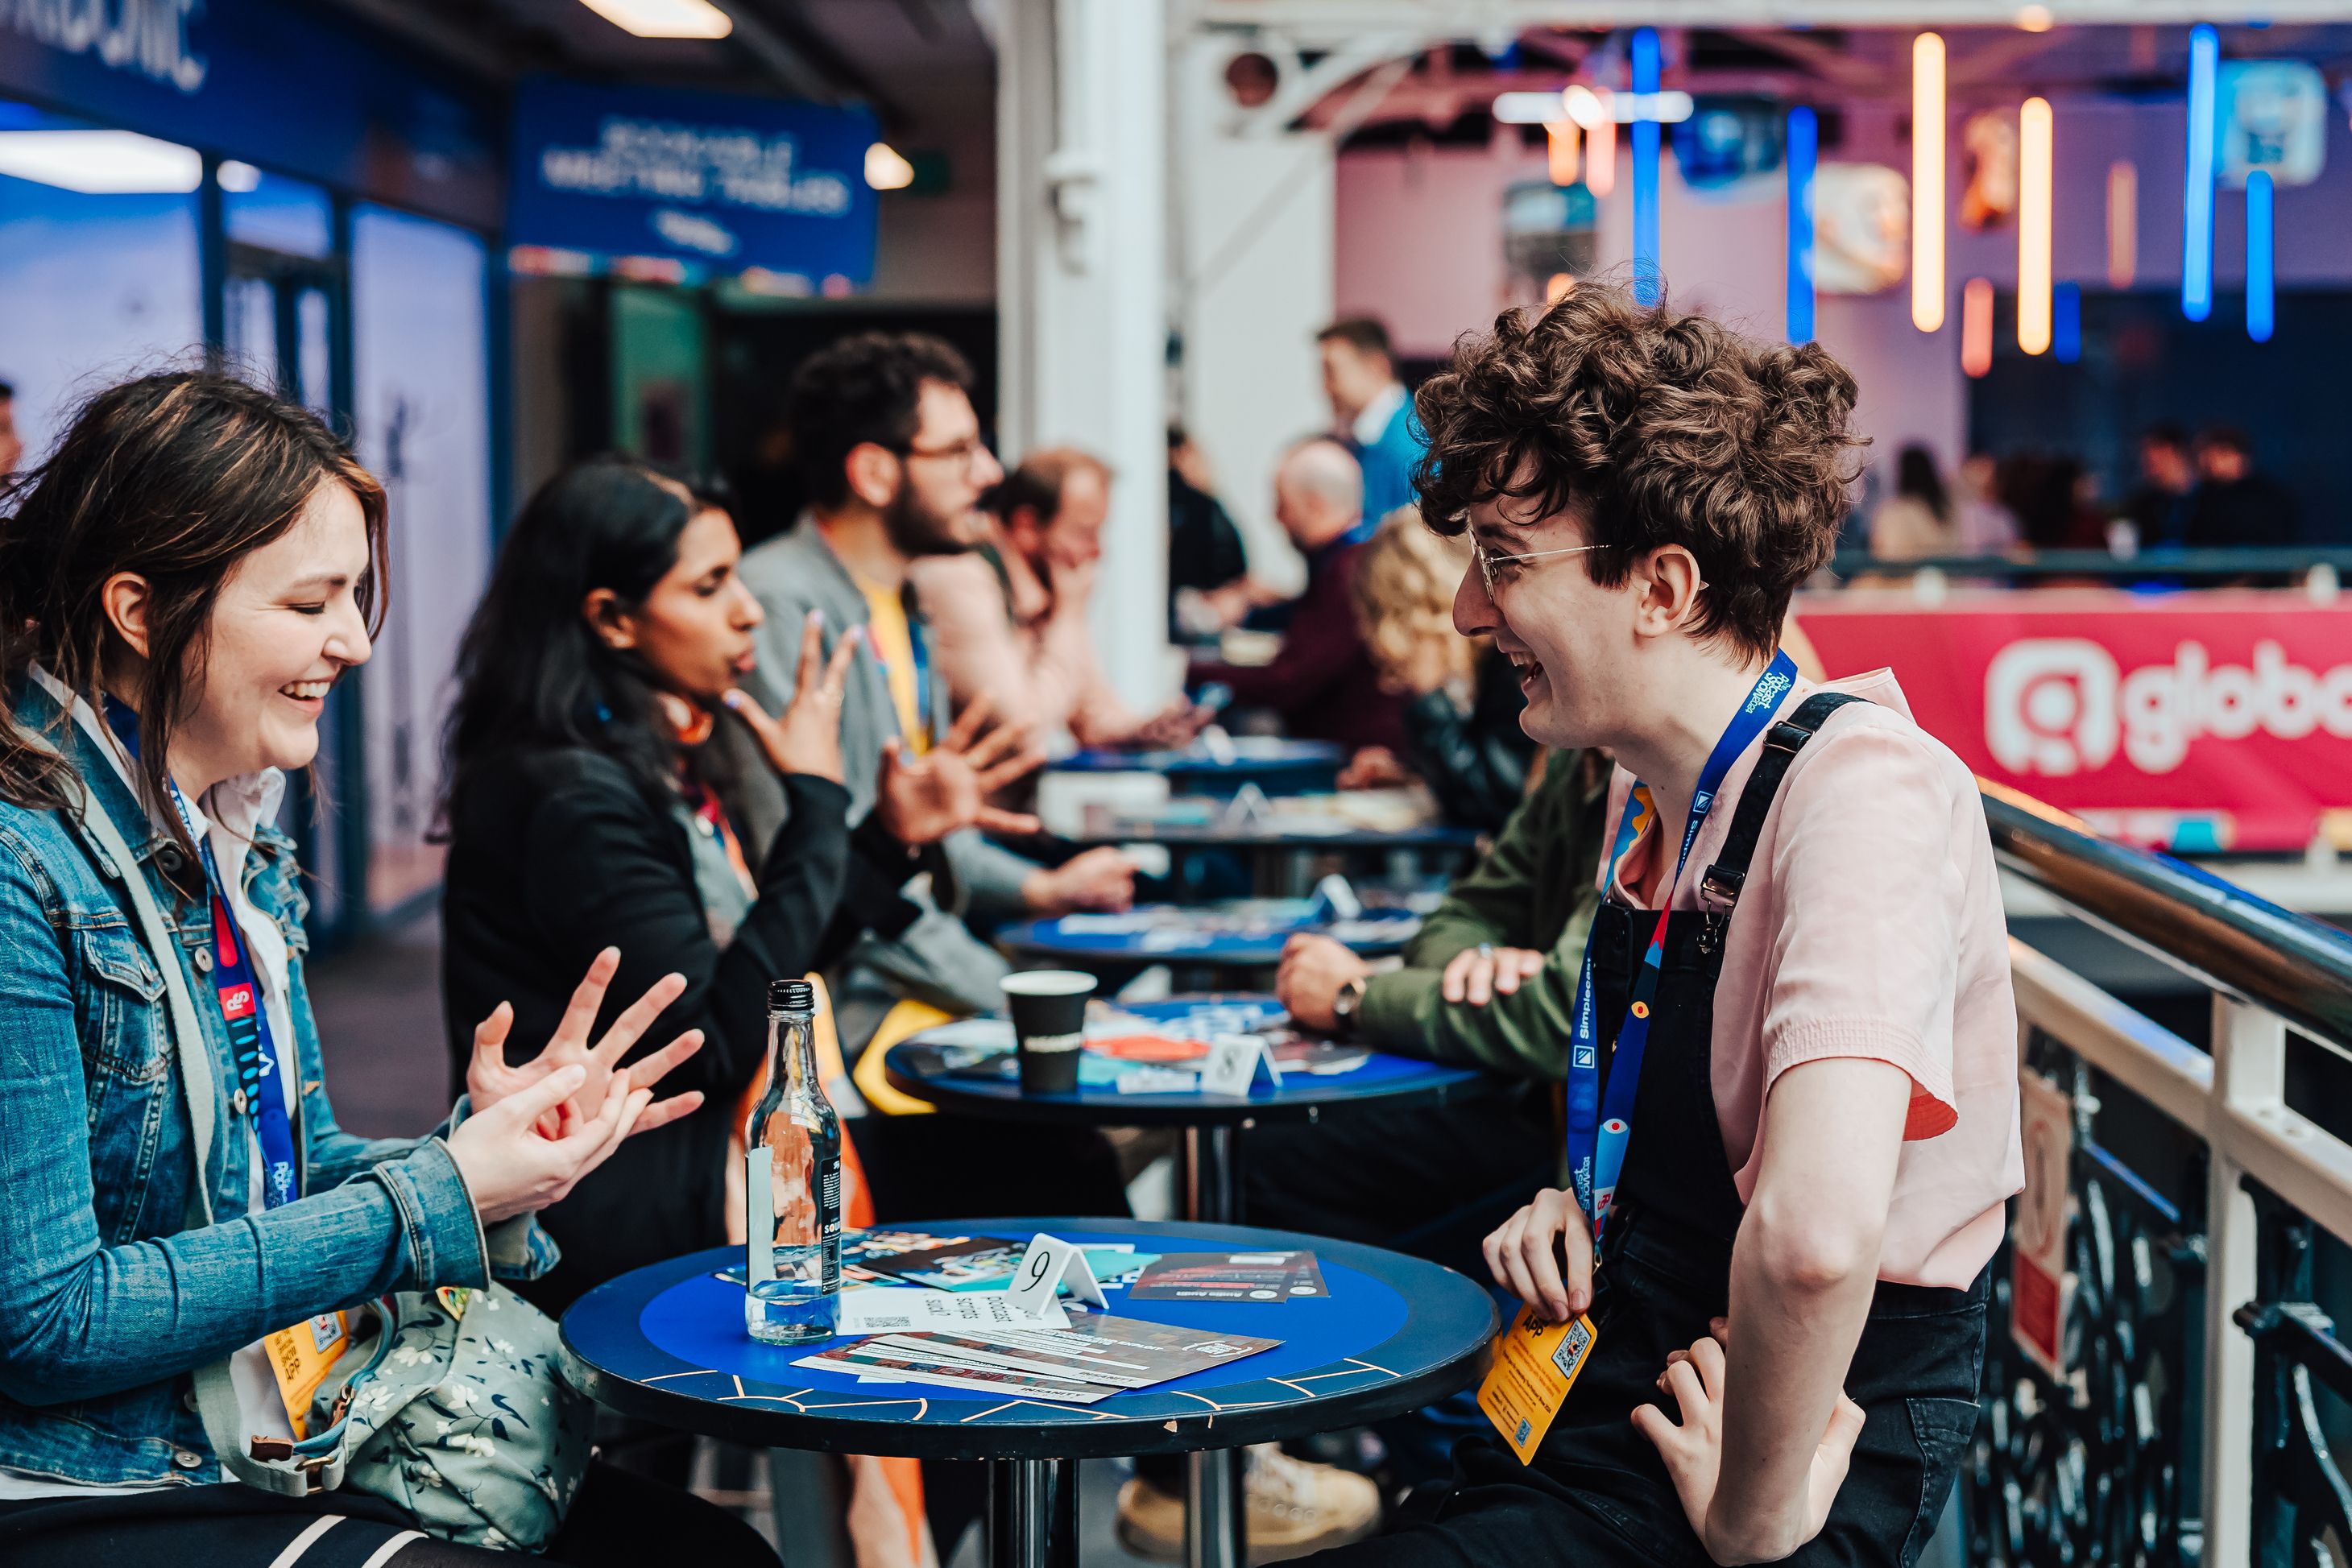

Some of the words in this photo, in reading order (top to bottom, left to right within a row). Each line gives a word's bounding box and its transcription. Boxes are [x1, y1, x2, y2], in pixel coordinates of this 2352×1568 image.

[1758, 672, 1790, 710] Podcast
[1216, 1043, 1242, 1082] 8
[1021, 1251, 1050, 1293] 9
[953, 1297, 981, 1319] scripts
[979, 1296, 1015, 1322] podcast
[1079, 1371, 1137, 1383] INSANITY
[1021, 1387, 1085, 1397] INSANITY
